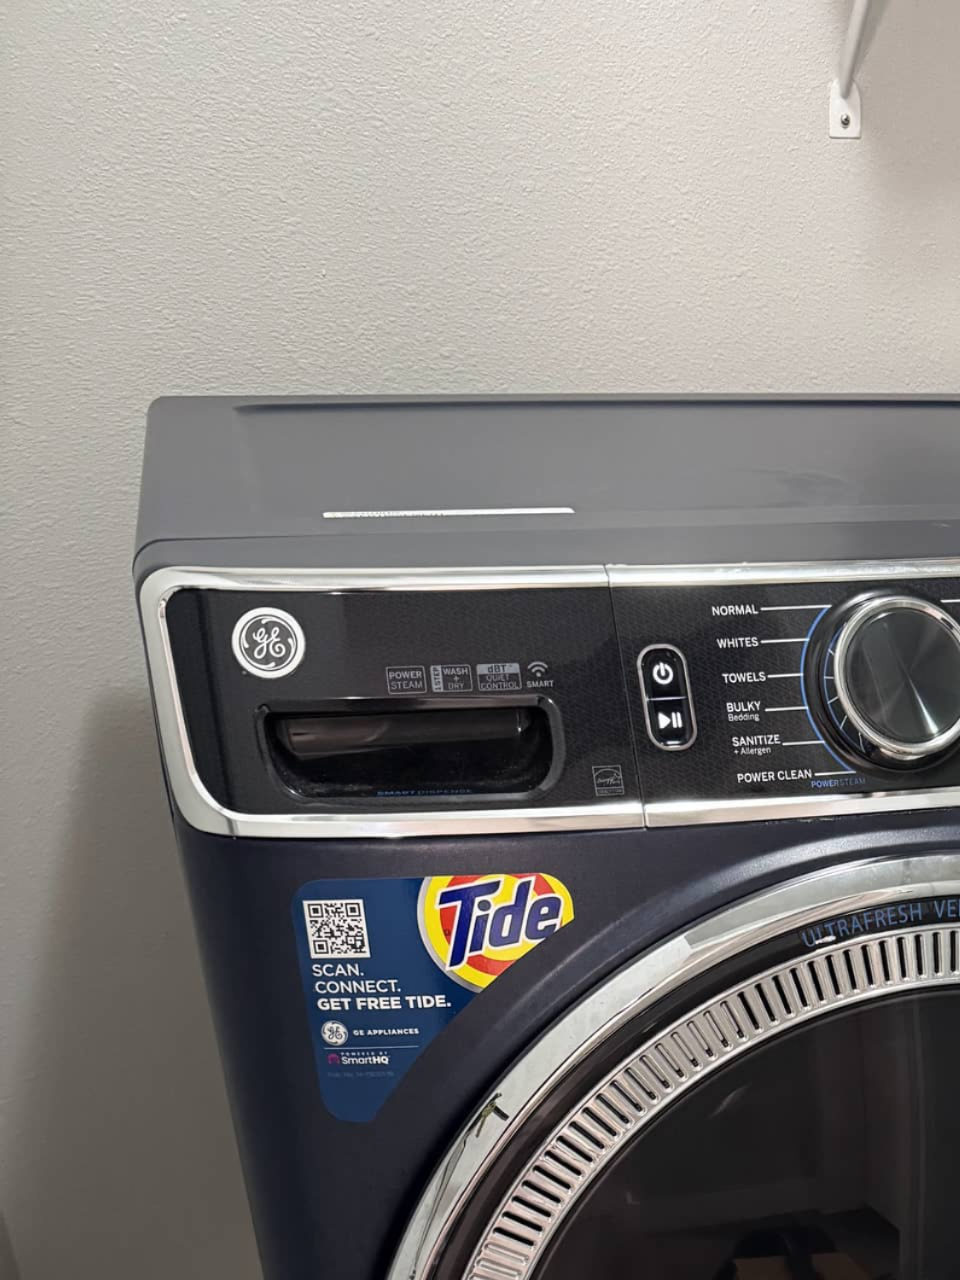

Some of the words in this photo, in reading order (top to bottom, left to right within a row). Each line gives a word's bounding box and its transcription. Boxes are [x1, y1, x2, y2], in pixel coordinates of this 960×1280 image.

[711, 604, 759, 616] NORMAL
[716, 637, 759, 649] WHITES
[389, 670, 423, 680] POWER
[442, 666, 468, 676] WASH
[486, 673, 510, 682] QUIET
[722, 671, 766, 684] TOWELS
[391, 680, 424, 690] STEAM
[448, 682, 465, 690] DRY
[480, 681, 519, 690] CONTROL
[526, 679, 554, 688] SMART
[726, 701, 761, 713] BULKY
[728, 713, 760, 722] Bedding
[732, 734, 781, 747] SANITIZE
[740, 746, 772, 756] Allergen
[737, 771, 775, 783] POWER
[777, 769, 812, 780] CLEAN
[437, 878, 562, 969] Tide
[312, 963, 364, 977] SCAN.
[315, 979, 401, 994] CONNECT.
[317, 997, 351, 1011] GET
[356, 996, 402, 1010] FREE
[405, 995, 451, 1008] TIDE.
[367, 1028, 419, 1036] APPLIANCES
[341, 1055, 389, 1065] SmartHQ
